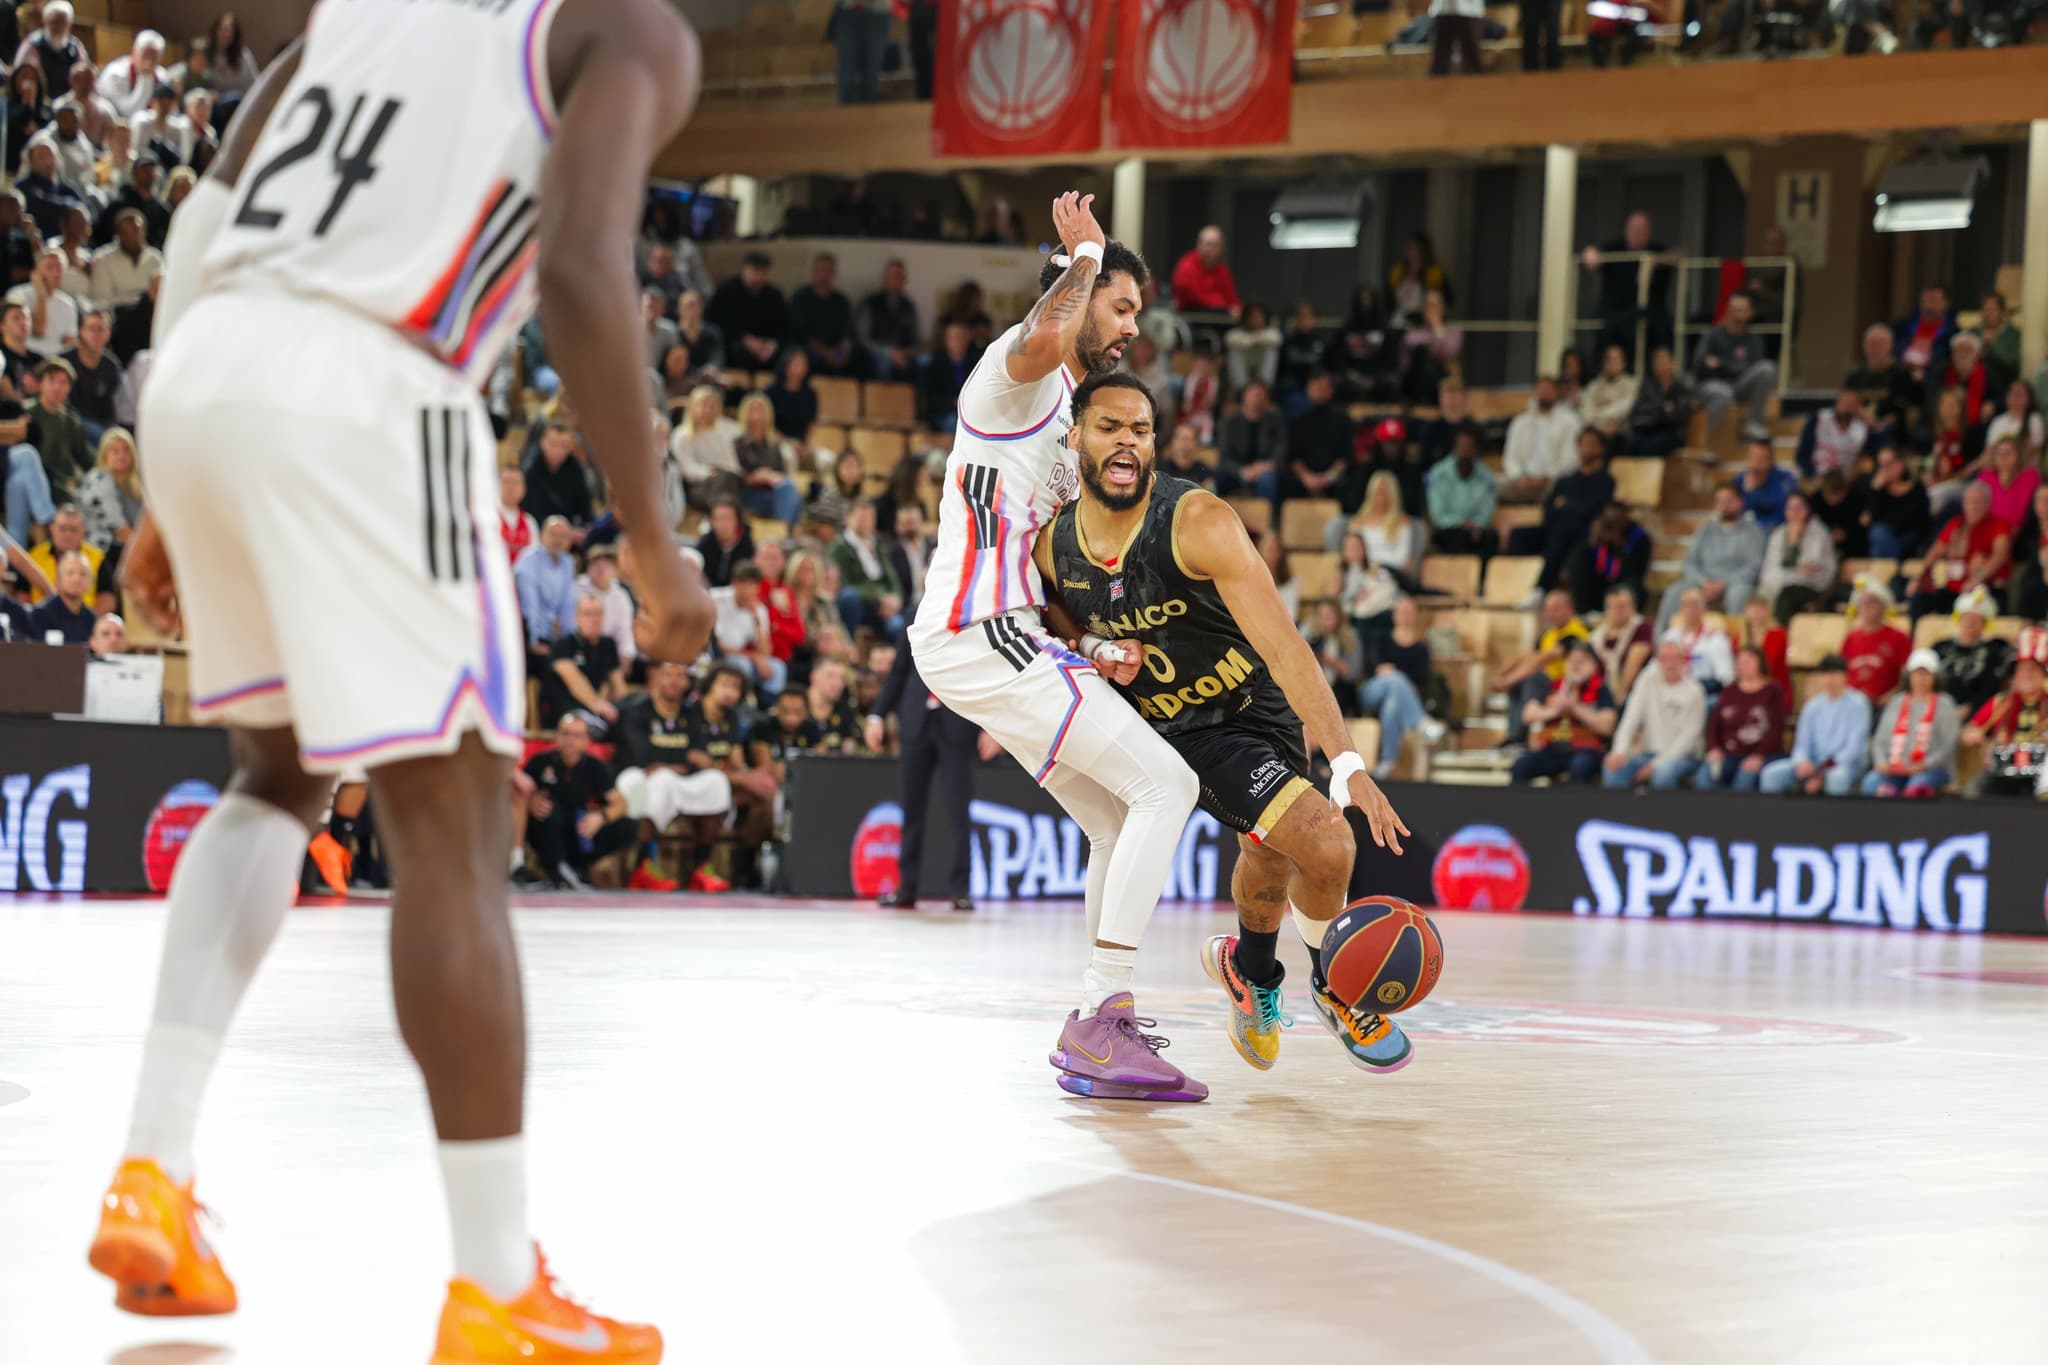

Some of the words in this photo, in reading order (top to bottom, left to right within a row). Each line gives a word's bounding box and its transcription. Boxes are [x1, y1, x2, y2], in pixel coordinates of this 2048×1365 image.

[233, 86, 403, 236] 24
[1788, 176, 1819, 220] H
[1063, 578, 1091, 590] SPALDING
[1573, 819, 1990, 931] SPALDING
